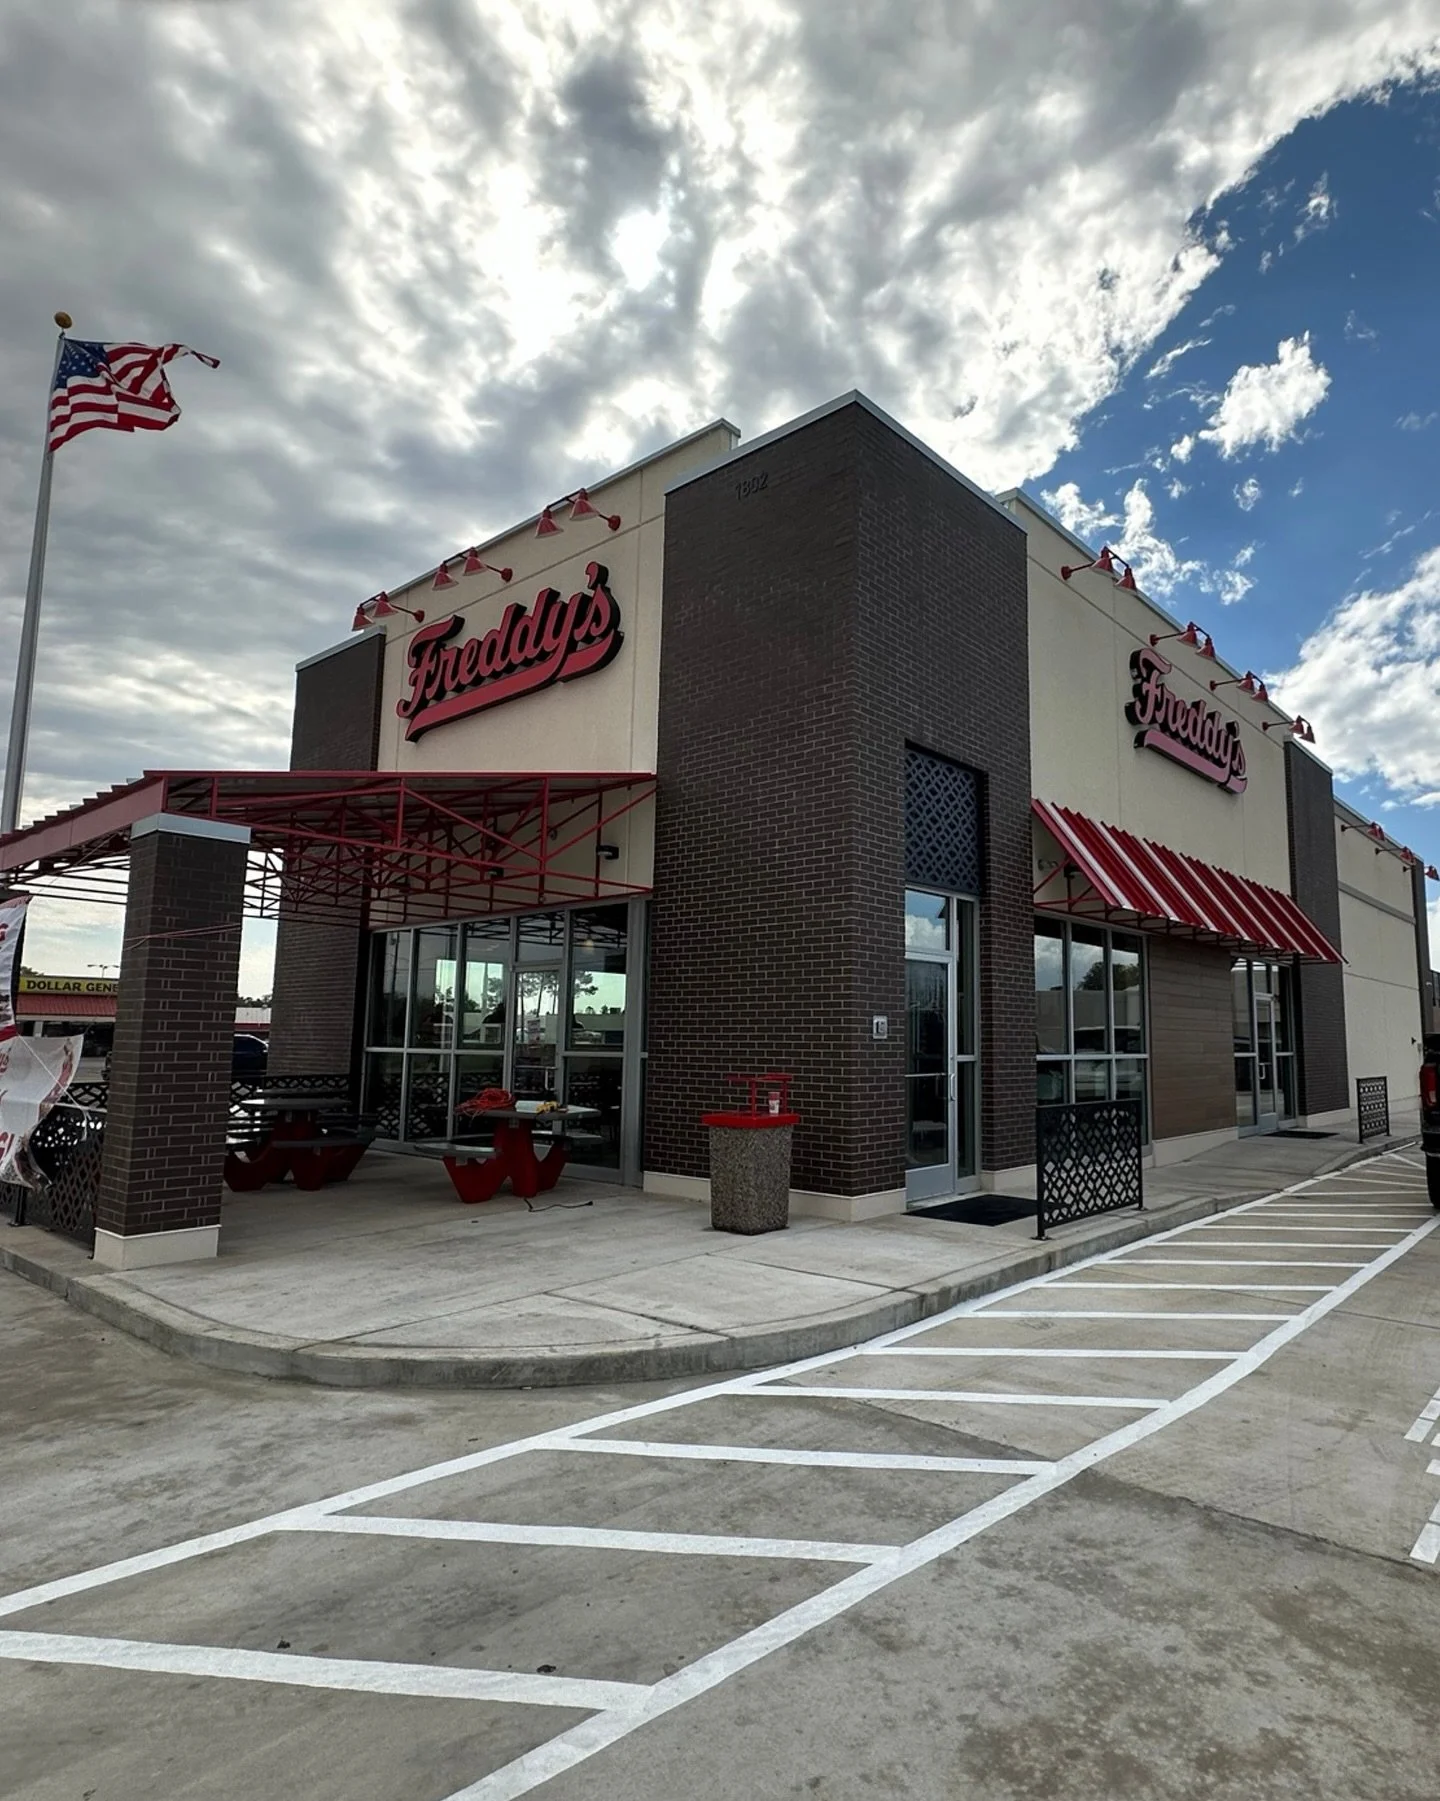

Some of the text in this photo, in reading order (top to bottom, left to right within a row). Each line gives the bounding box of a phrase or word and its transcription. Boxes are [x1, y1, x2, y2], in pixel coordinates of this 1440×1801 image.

[396, 561, 624, 743] Freddy's
[1125, 648, 1248, 795] Freddy's
[26, 980, 82, 992] DOLLAR
